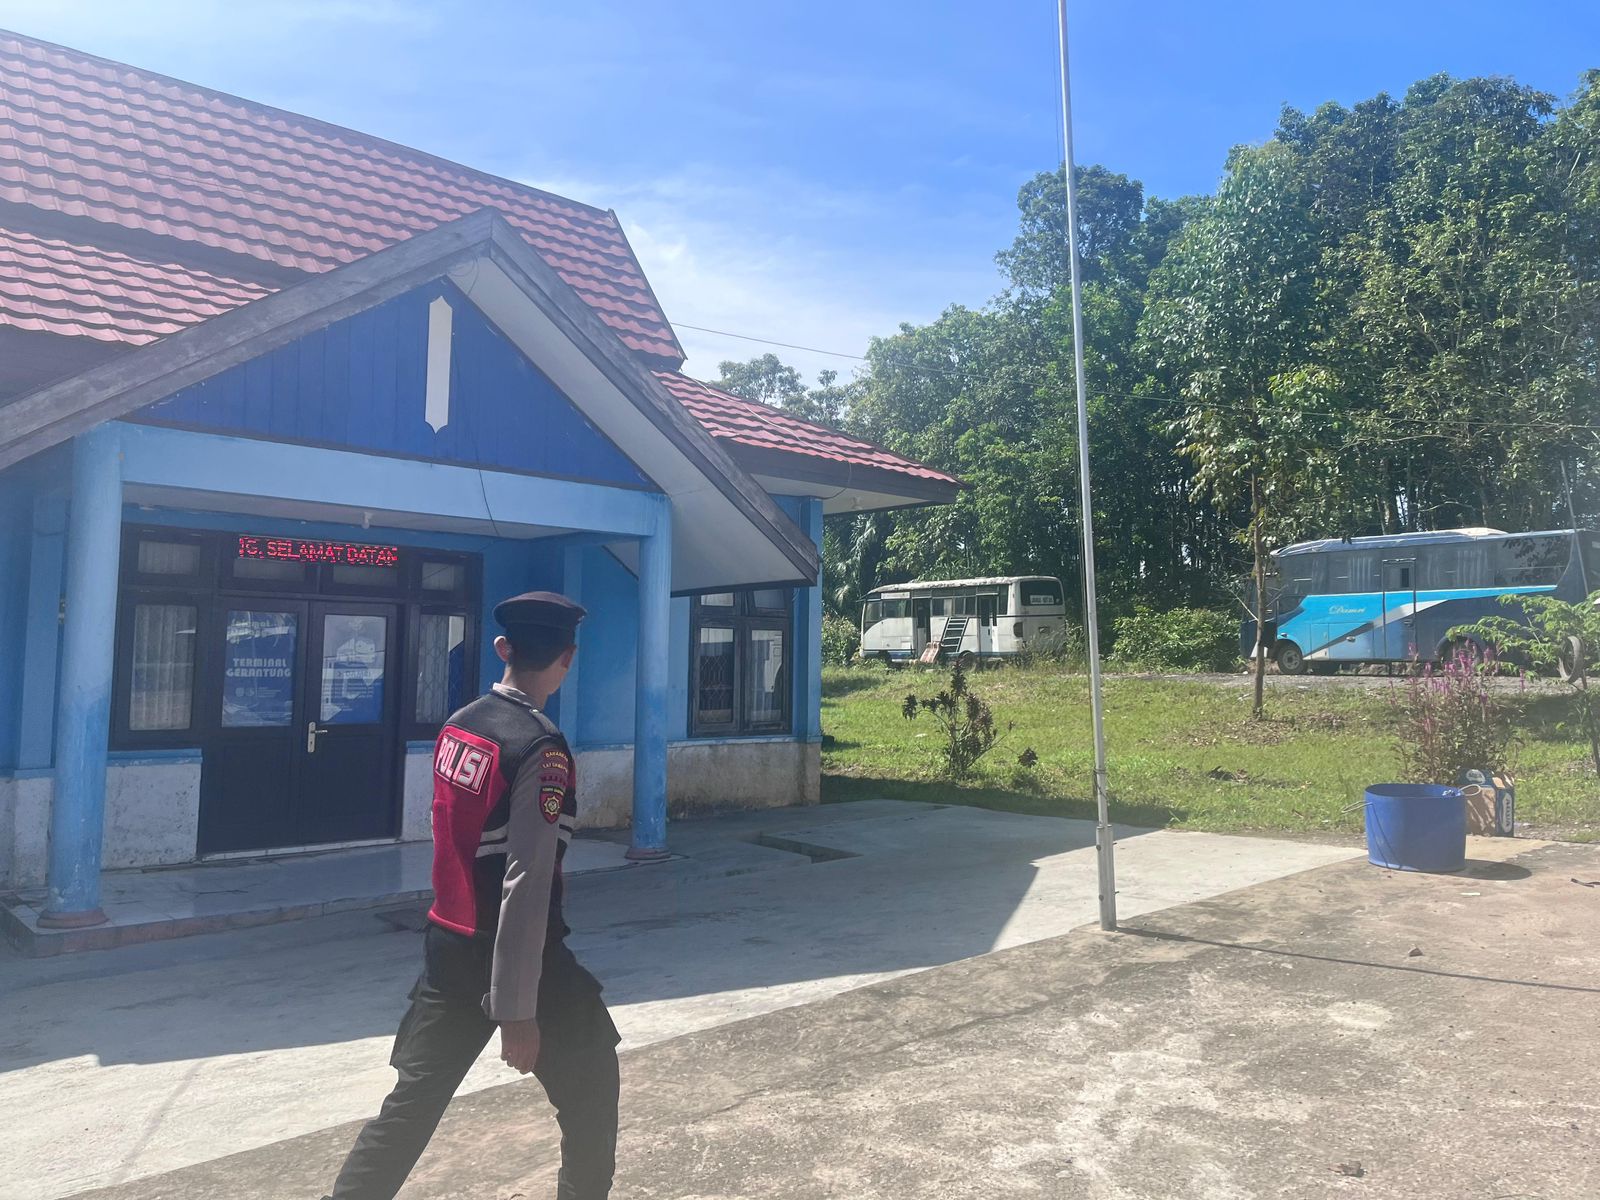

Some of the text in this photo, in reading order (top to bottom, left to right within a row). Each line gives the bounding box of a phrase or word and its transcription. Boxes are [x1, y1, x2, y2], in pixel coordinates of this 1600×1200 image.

[267, 540, 344, 562] SELAMAT
[232, 657, 286, 667] TERMINAL
[435, 734, 489, 790] POLISI
